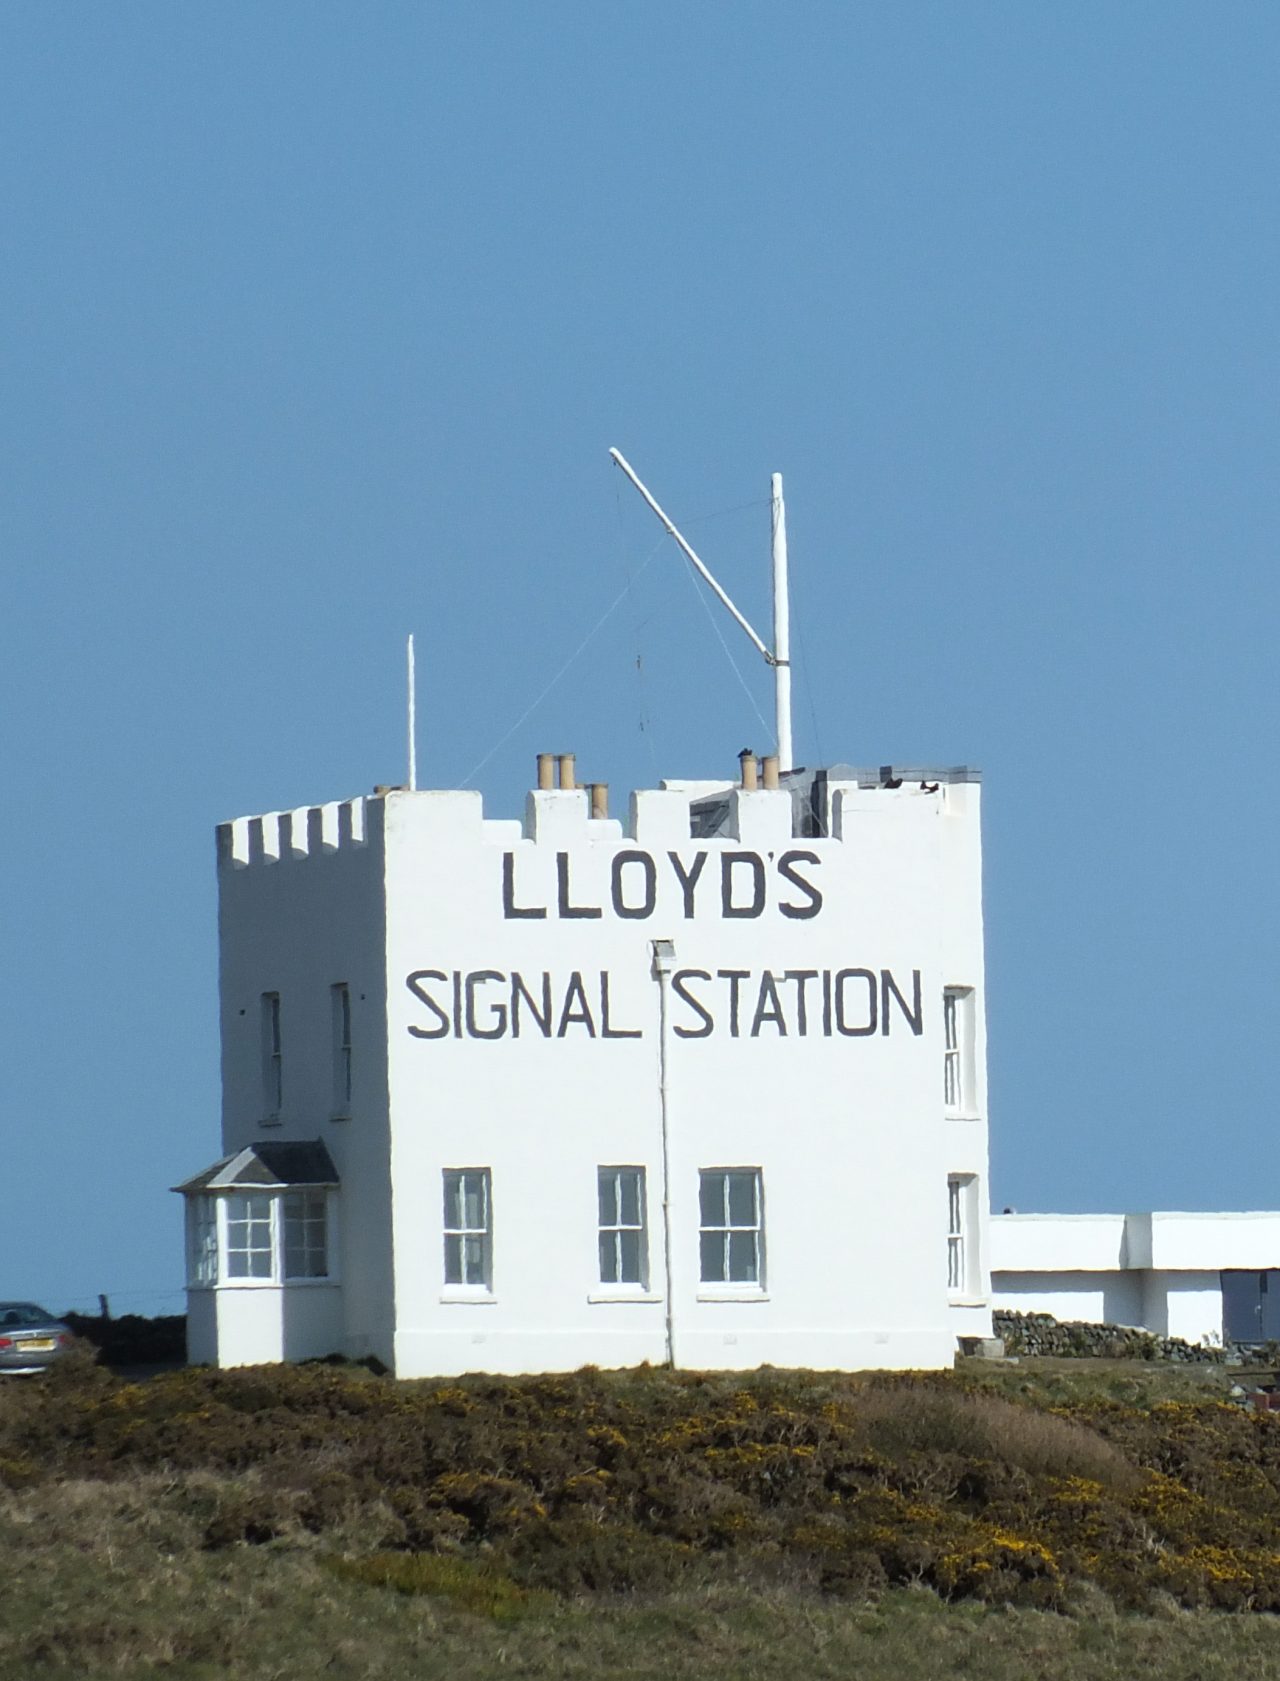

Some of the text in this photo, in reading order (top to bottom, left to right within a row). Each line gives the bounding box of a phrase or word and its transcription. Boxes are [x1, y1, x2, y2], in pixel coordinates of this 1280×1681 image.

[502, 850, 823, 920] LLOYD'S
[406, 968, 923, 1039] SIGNAL STATION
